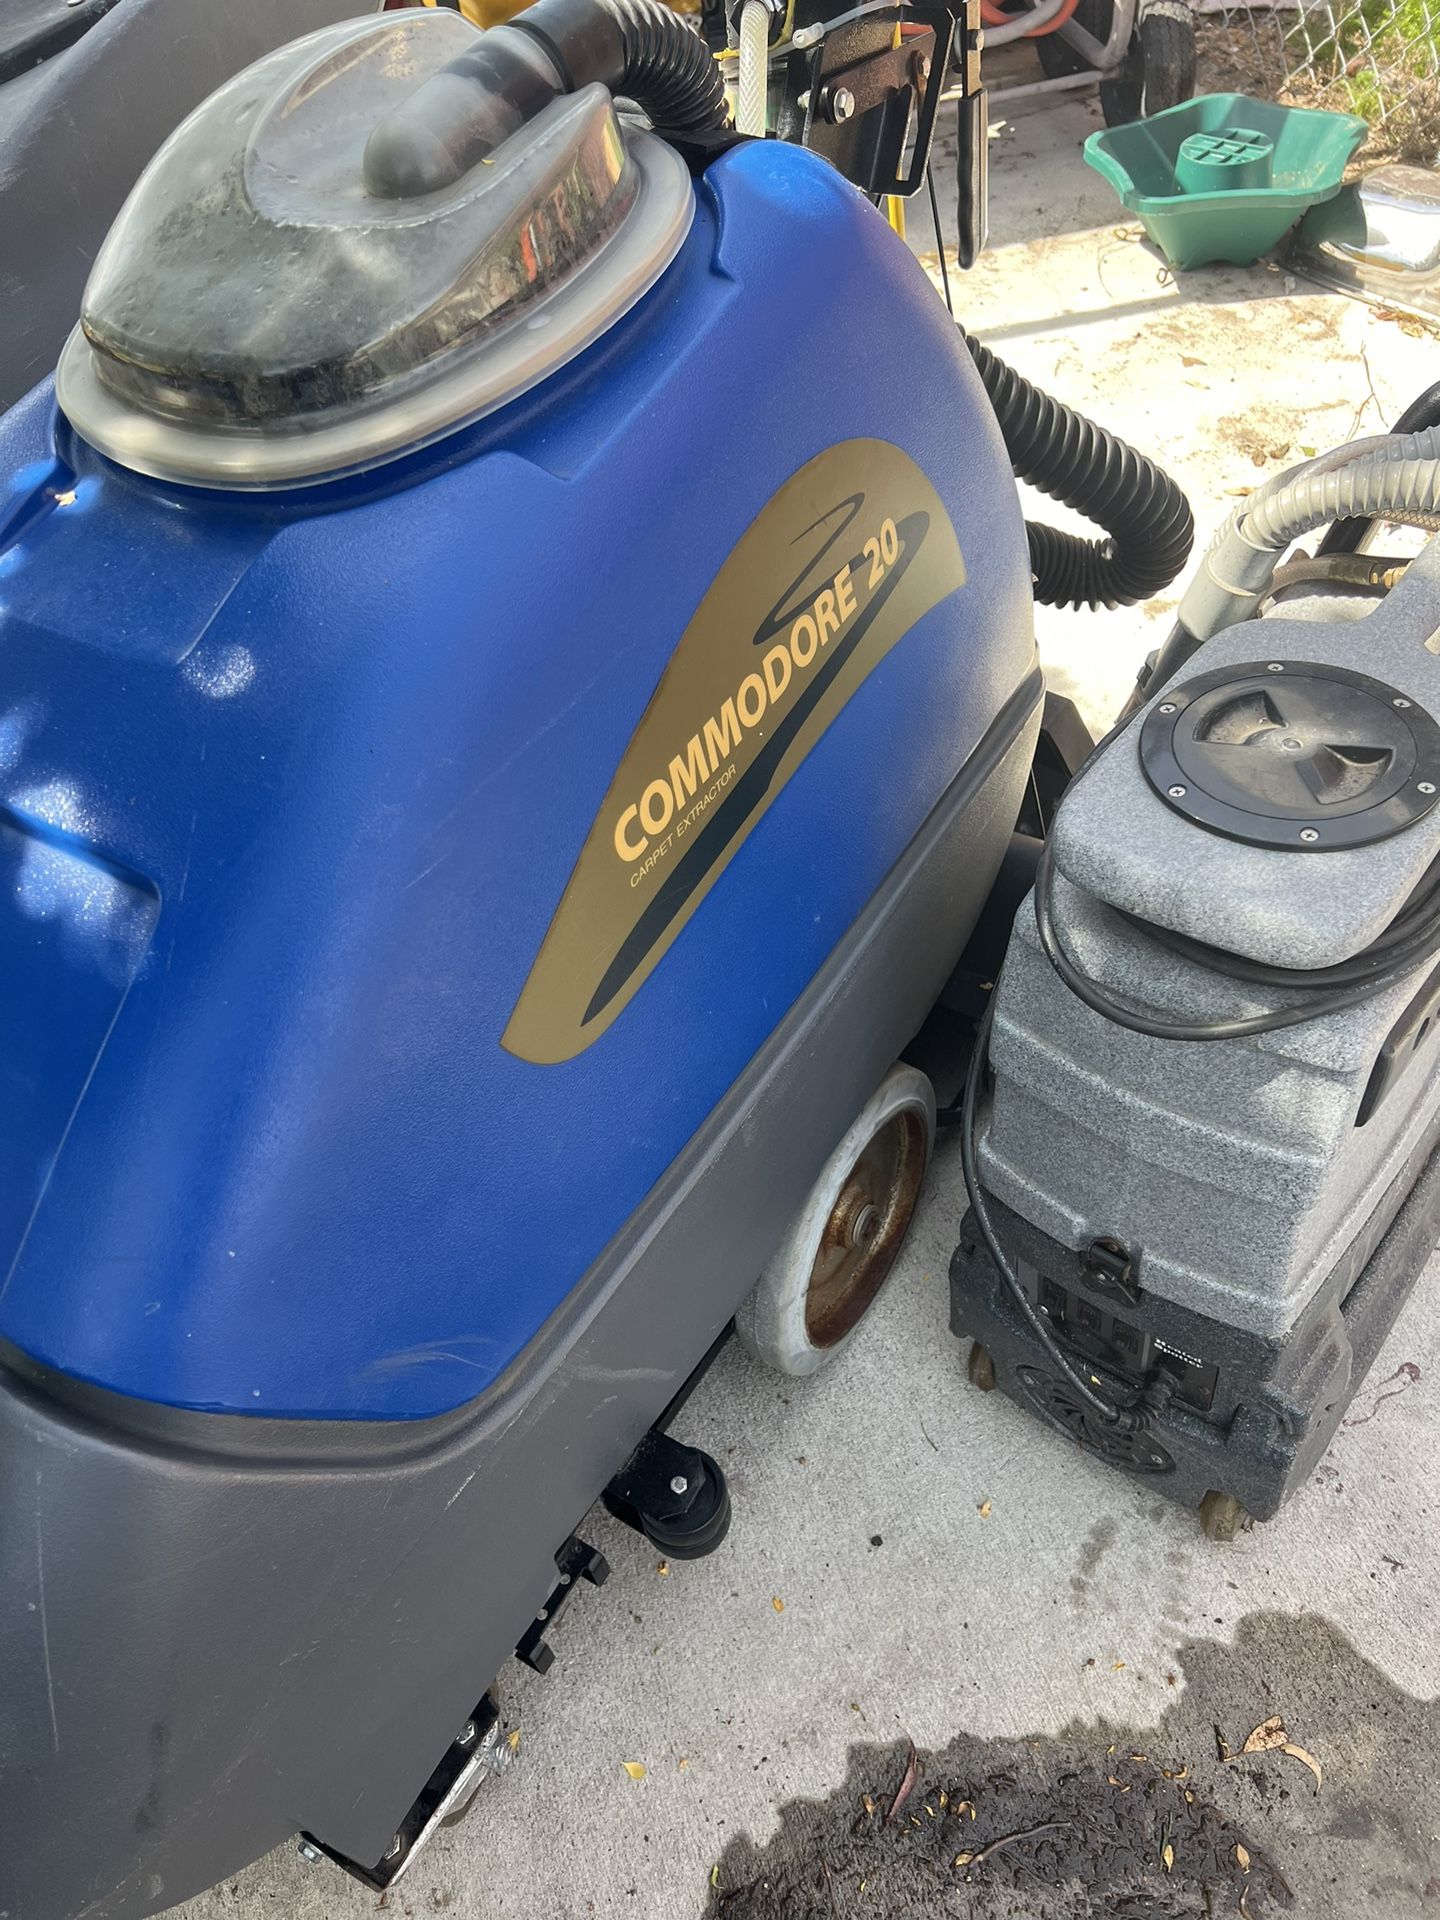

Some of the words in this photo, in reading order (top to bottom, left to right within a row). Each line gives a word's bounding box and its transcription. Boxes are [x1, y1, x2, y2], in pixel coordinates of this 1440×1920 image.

[614, 563, 858, 862] COMMODORE
[862, 517, 899, 590] 20
[630, 832, 674, 888] CARPET
[676, 763, 737, 838] EXTRACTOR
